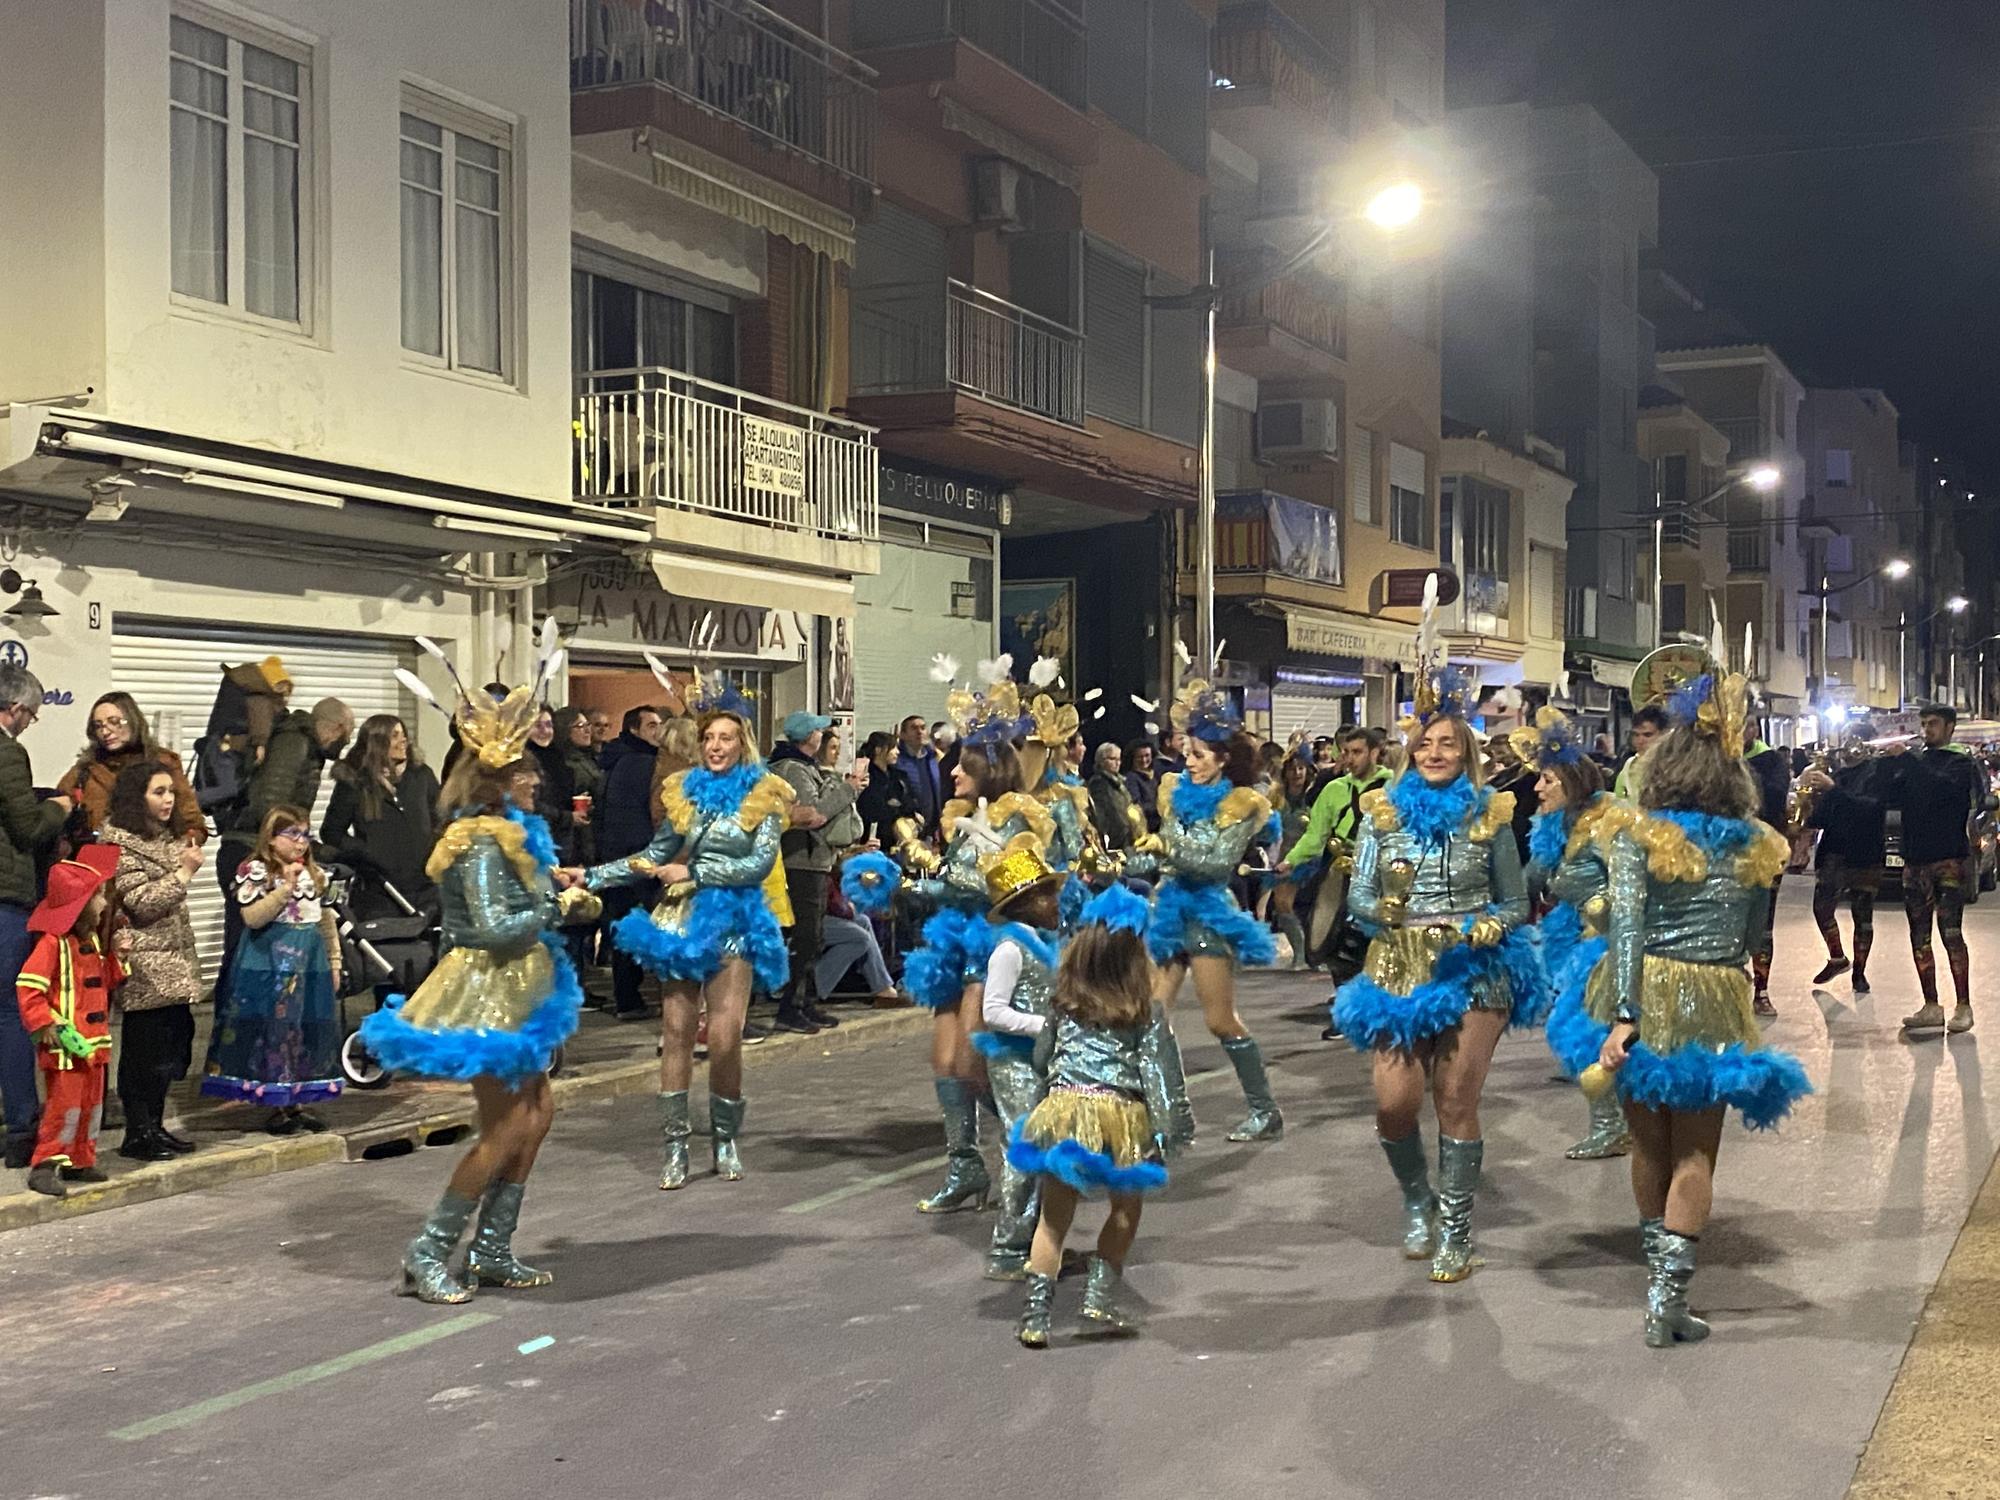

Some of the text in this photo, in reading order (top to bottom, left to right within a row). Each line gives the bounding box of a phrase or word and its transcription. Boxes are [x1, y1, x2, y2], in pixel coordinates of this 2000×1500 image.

[746, 423, 800, 453] SE ALQUILAN
[744, 442, 801, 473] APARTAMENTOS
[90, 604, 99, 627] 9
[1296, 627, 1315, 643] BAR
[1321, 629, 1367, 650] CAFETERIA
